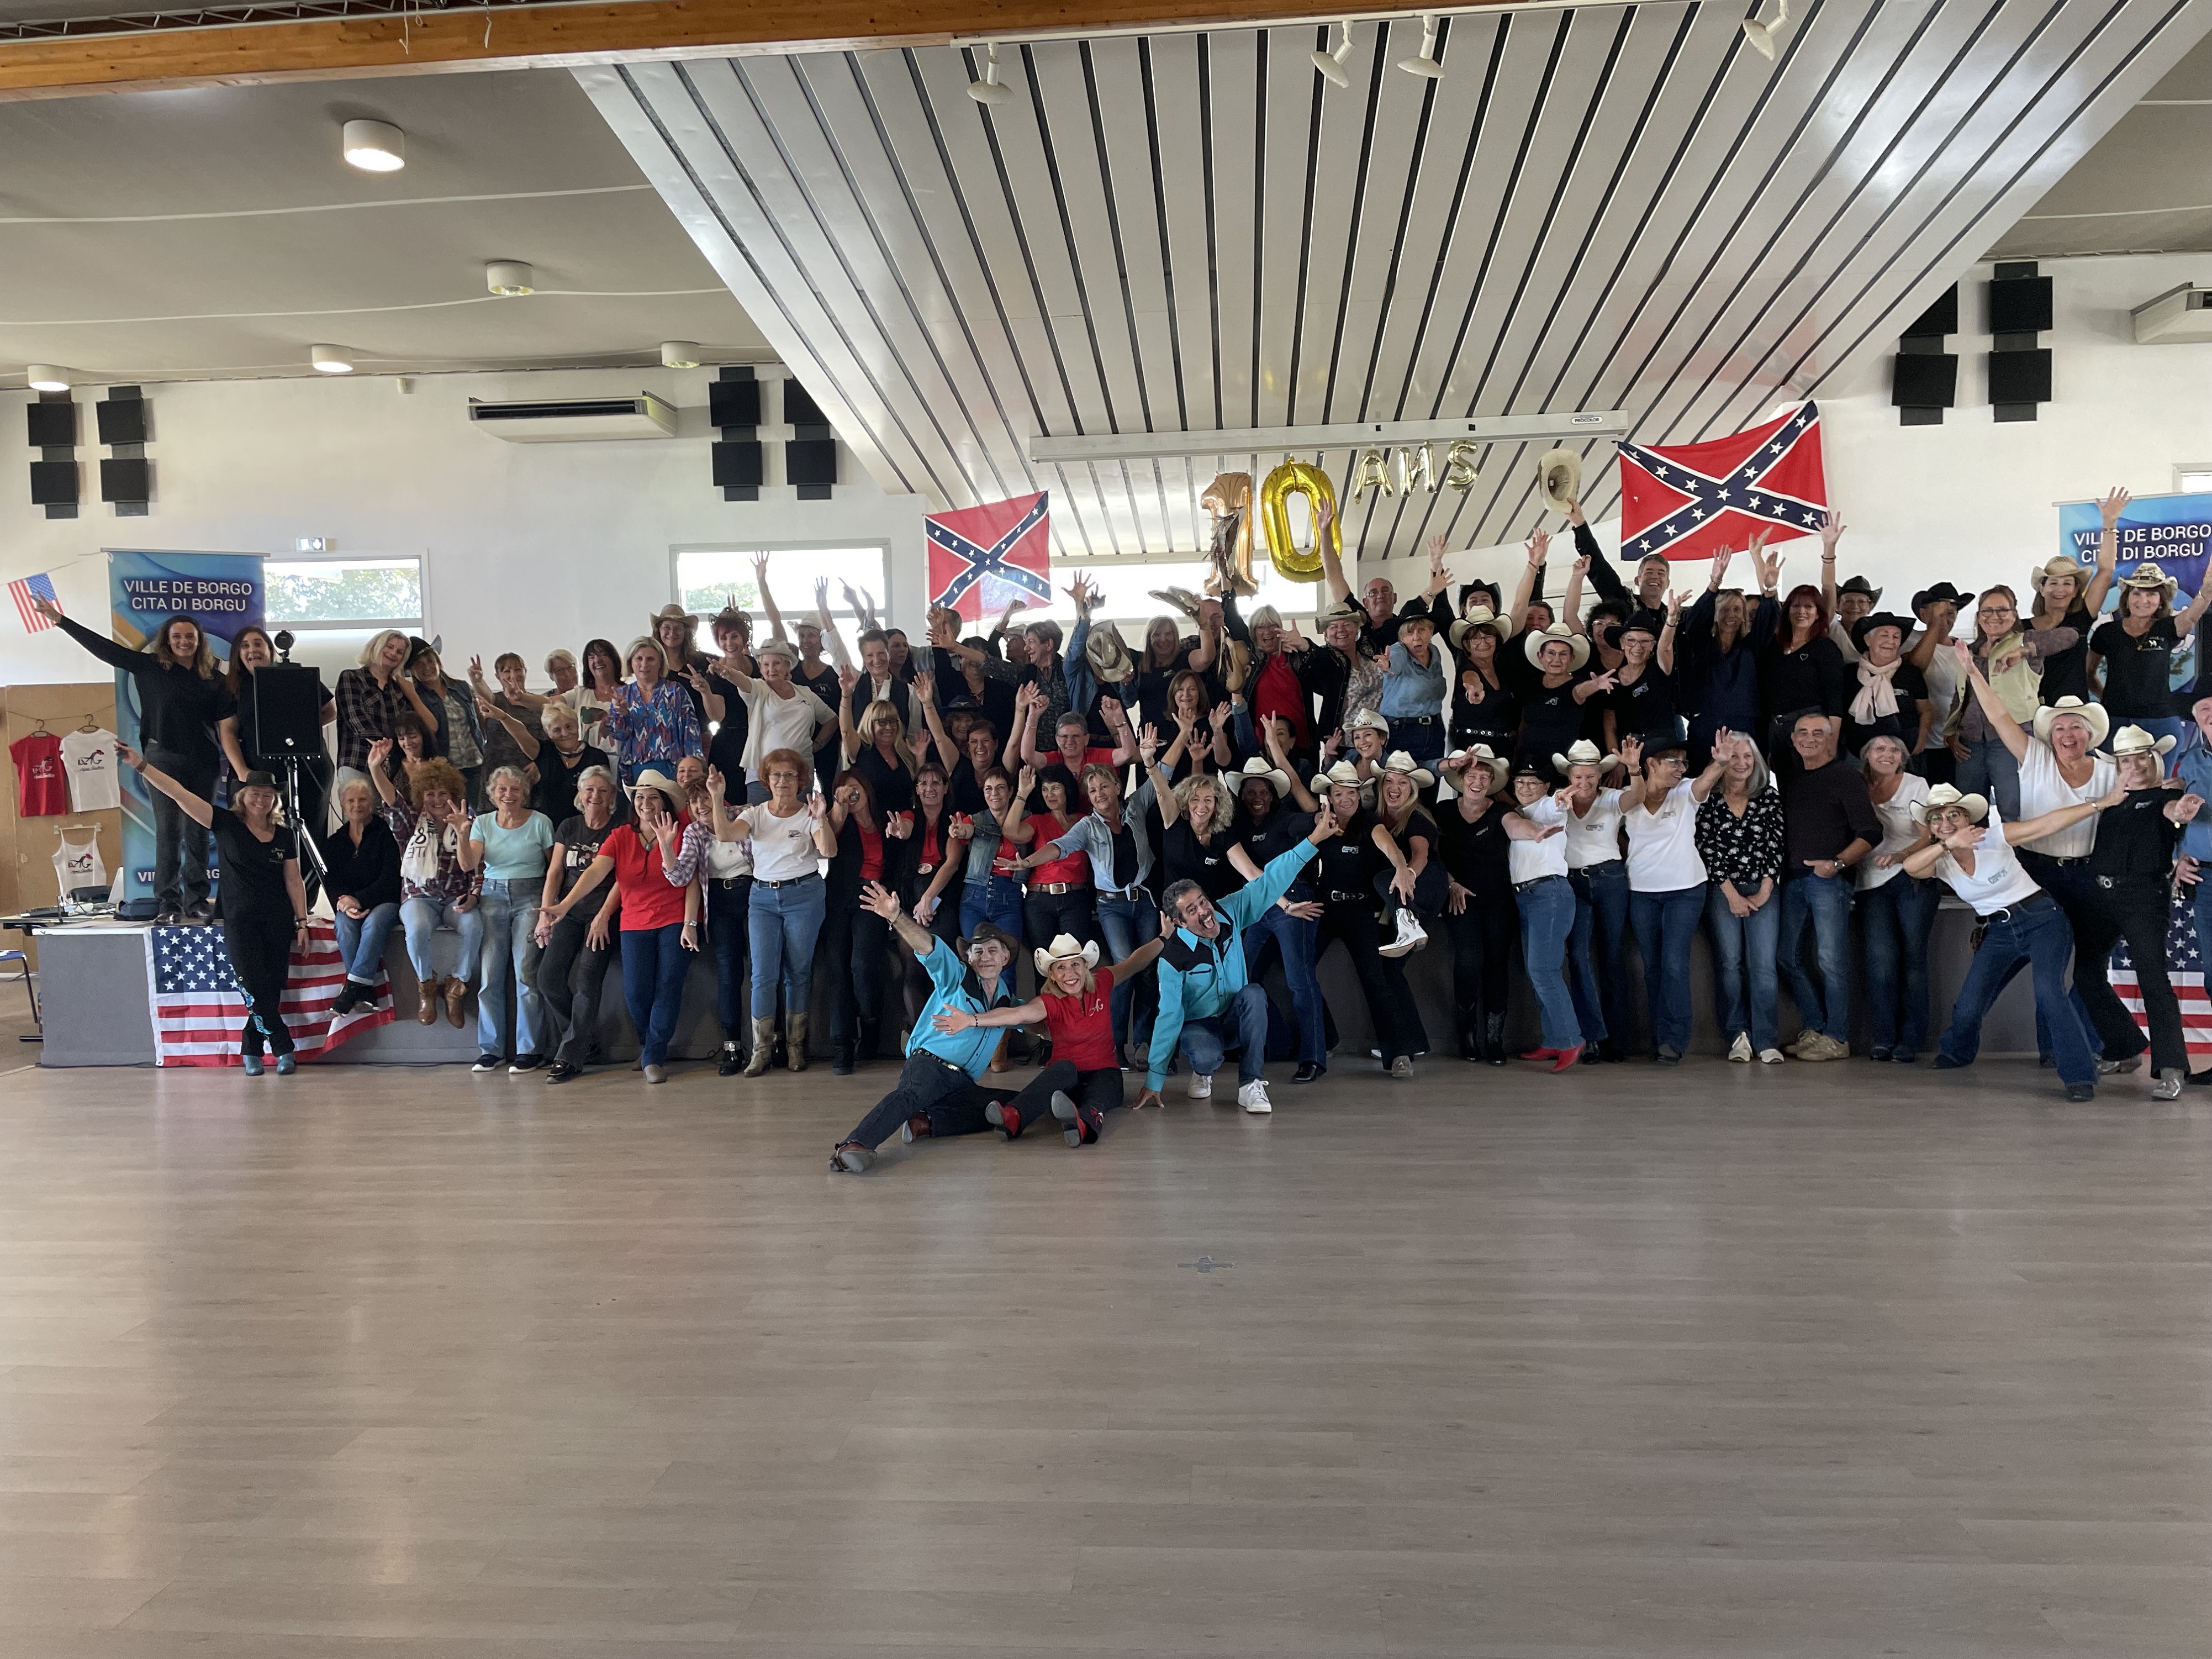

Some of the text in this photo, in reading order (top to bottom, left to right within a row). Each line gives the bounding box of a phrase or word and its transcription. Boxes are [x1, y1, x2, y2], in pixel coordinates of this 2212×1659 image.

[1201, 457, 1343, 598] 10
[2124, 528, 2147, 543] DE
[2151, 524, 2211, 541] BORGO
[2123, 546, 2139, 560] DI
[2144, 543, 2204, 560] BORGU
[124, 580, 252, 596] VILLE DE BORGO
[132, 597, 246, 612] CITA DI BORGU
